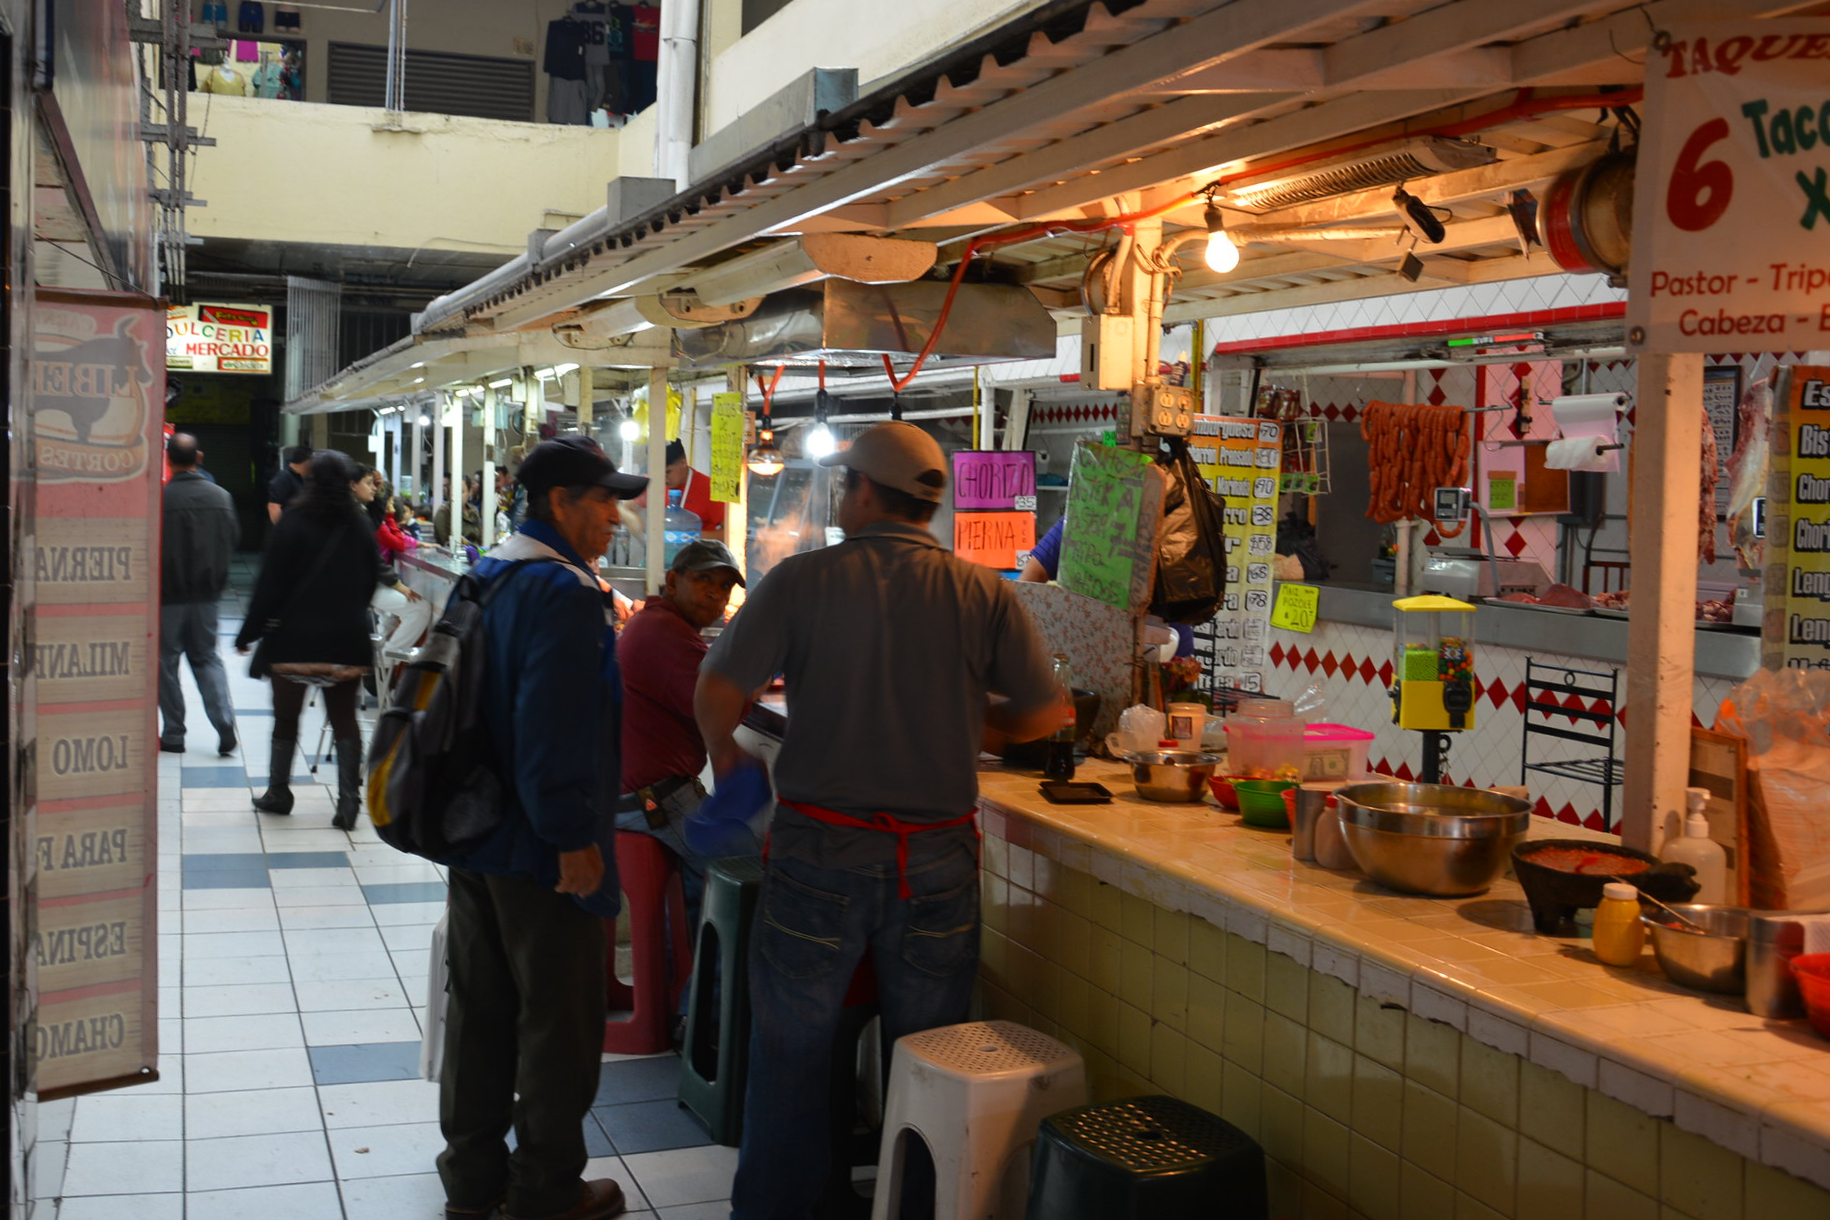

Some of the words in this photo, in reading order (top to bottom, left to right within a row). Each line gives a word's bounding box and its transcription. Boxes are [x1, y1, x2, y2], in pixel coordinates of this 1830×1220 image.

[1666, 117, 1734, 231] 6
[1650, 271, 1738, 297] Pastor
[1770, 263, 1830, 295] Trip
[1679, 308, 1786, 337] Cabeza
[186, 343, 268, 357] MERCADO
[1799, 424, 1830, 456] Bis
[959, 463, 1030, 499] CHORIZO
[957, 521, 1016, 550] PIERNA
[1791, 614, 1830, 645] Len
